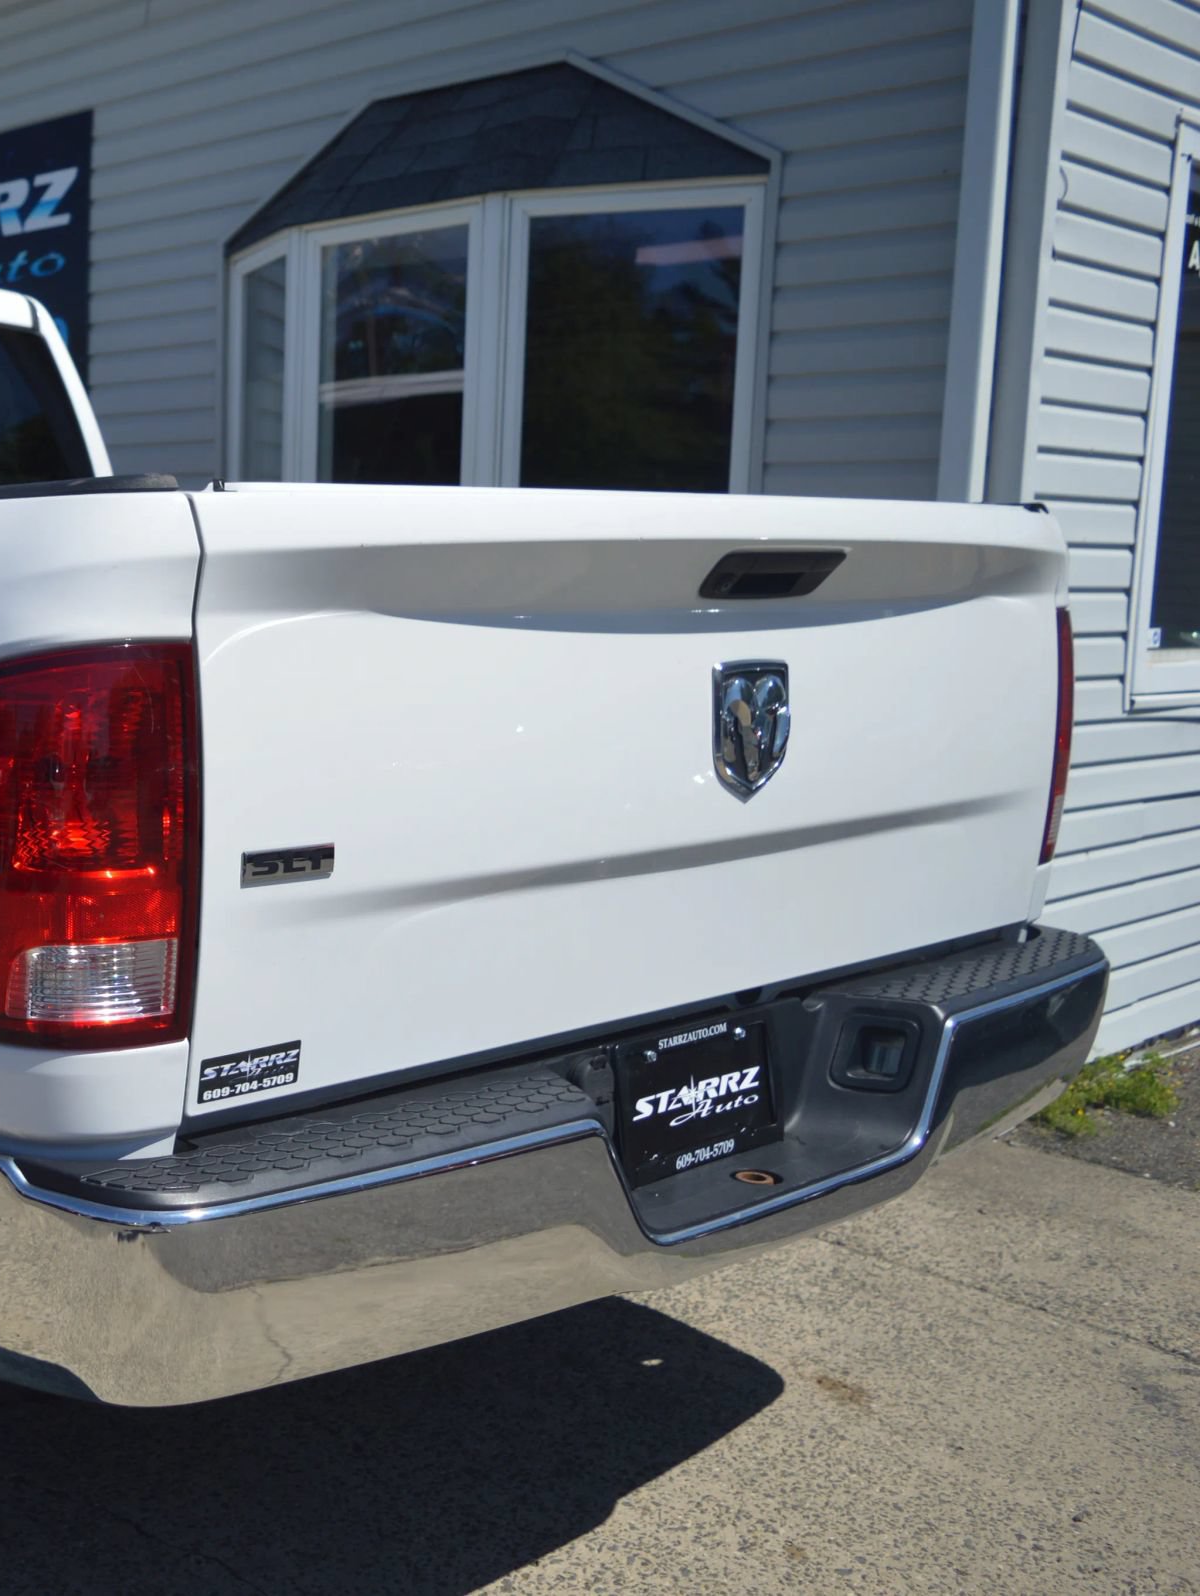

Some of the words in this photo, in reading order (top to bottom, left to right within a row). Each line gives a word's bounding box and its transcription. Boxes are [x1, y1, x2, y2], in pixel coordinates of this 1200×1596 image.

[246, 848, 334, 880] SLT
[658, 1022, 727, 1050] STARRZAUTO.COM
[201, 1049, 299, 1081] STARRZ
[203, 1072, 294, 1101] 609-704-5709
[632, 1065, 760, 1121] STARRZ
[669, 1094, 759, 1127] Auto
[676, 1139, 735, 1170] 609-704-5709
